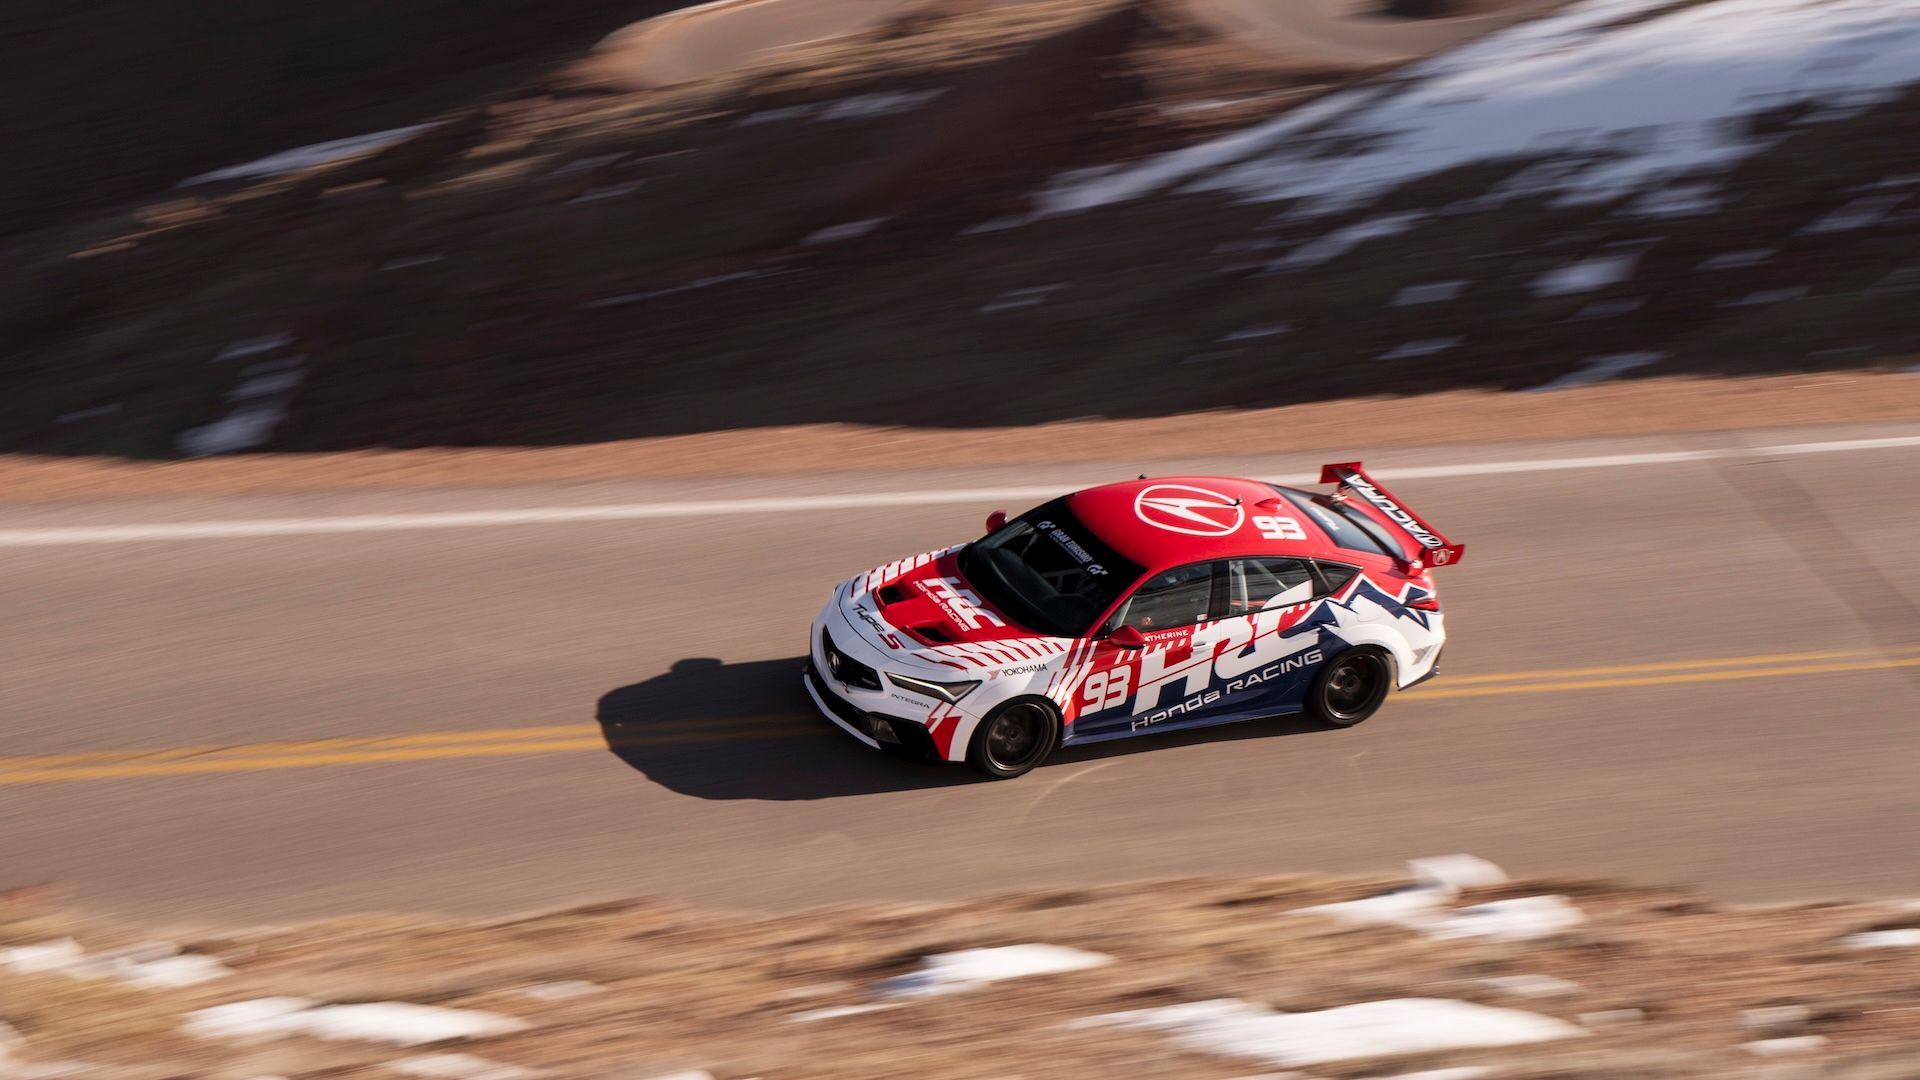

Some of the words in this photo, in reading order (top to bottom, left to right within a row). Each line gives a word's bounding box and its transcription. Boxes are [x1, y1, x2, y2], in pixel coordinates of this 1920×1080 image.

[1251, 515, 1307, 540] 93
[1345, 474, 1430, 535] ACURA
[1051, 529, 1071, 543] GRAN
[1065, 540, 1093, 563] TURISMO
[852, 603, 885, 633] Type
[878, 633, 906, 650] S
[912, 580, 941, 604] Honda
[939, 602, 971, 632] RACING
[921, 576, 1006, 630] HRC
[1131, 579, 1322, 717] HRC
[1143, 630, 1189, 642] ATHERINE
[1001, 663, 1048, 677] YOKOHAMA
[1080, 664, 1132, 718] 93
[1131, 689, 1221, 732] Honda
[1226, 648, 1324, 695] RACING
[891, 693, 930, 709] INTEGRA
